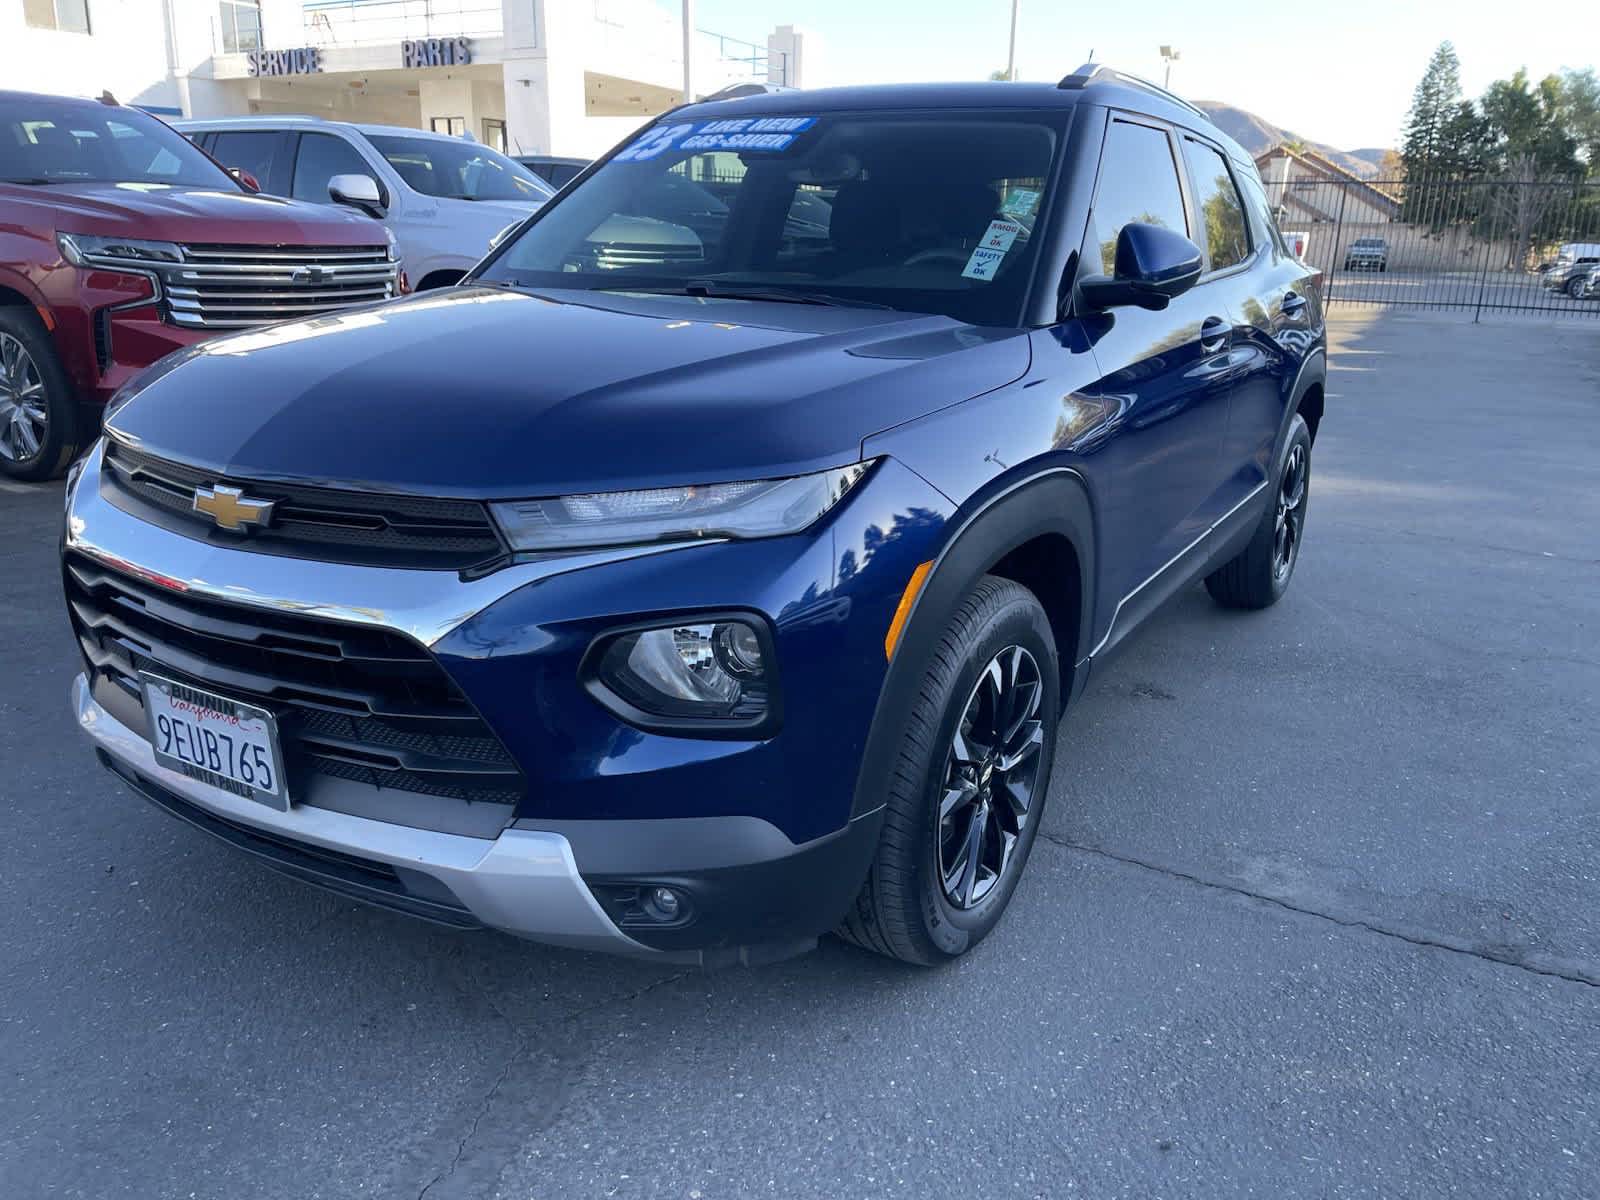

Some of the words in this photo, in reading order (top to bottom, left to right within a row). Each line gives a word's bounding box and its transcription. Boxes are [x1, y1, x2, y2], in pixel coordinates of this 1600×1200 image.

[247, 46, 324, 77] SERVICE
[401, 37, 470, 69] PARTS
[697, 119, 754, 134] LIKE
[748, 117, 812, 132] NEW
[991, 223, 1017, 233] SMOG
[990, 239, 1002, 247] OK
[975, 250, 1001, 261] SAFETY
[973, 267, 985, 276] OK
[171, 684, 235, 716] BUNNIN
[158, 714, 272, 790] 9EUB765
[183, 762, 217, 784] SANTA
[219, 772, 255, 798] PAULA
